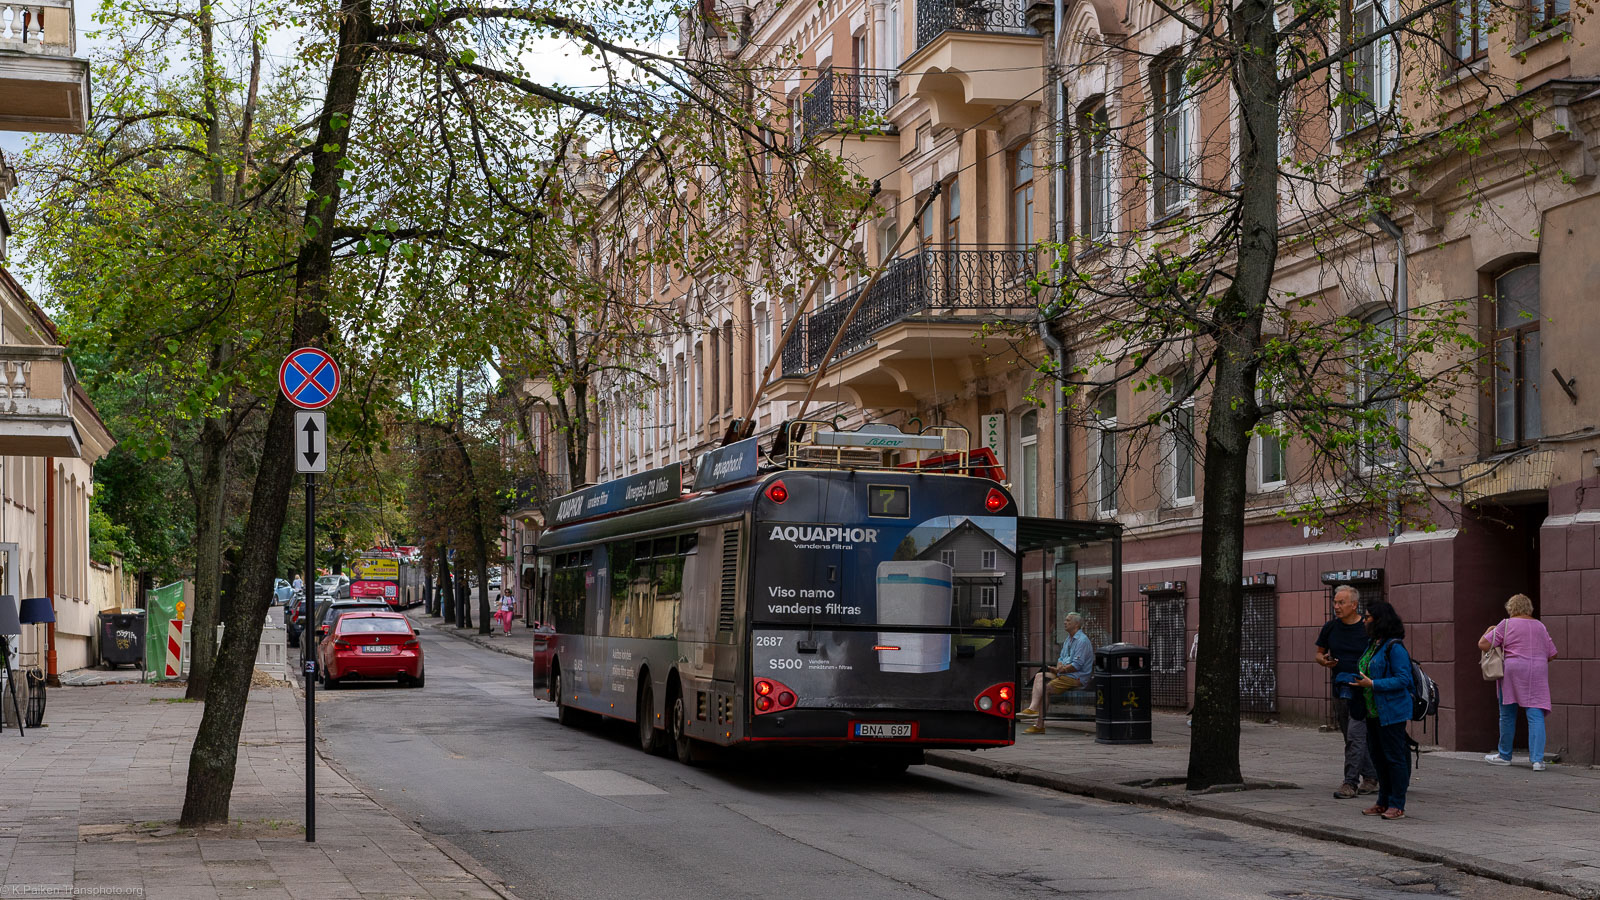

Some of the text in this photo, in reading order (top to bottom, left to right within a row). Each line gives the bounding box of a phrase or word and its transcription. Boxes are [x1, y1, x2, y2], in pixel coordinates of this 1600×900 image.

[879, 489, 896, 513] 7
[556, 495, 584, 522] AQUAPHOR
[769, 526, 877, 543] AQUAPHOR
[768, 586, 835, 598] Viso namo
[768, 602, 861, 615] vandens filtras
[756, 636, 784, 647] 2687
[770, 658, 803, 670] S500
[861, 725, 910, 735] BNA 687
